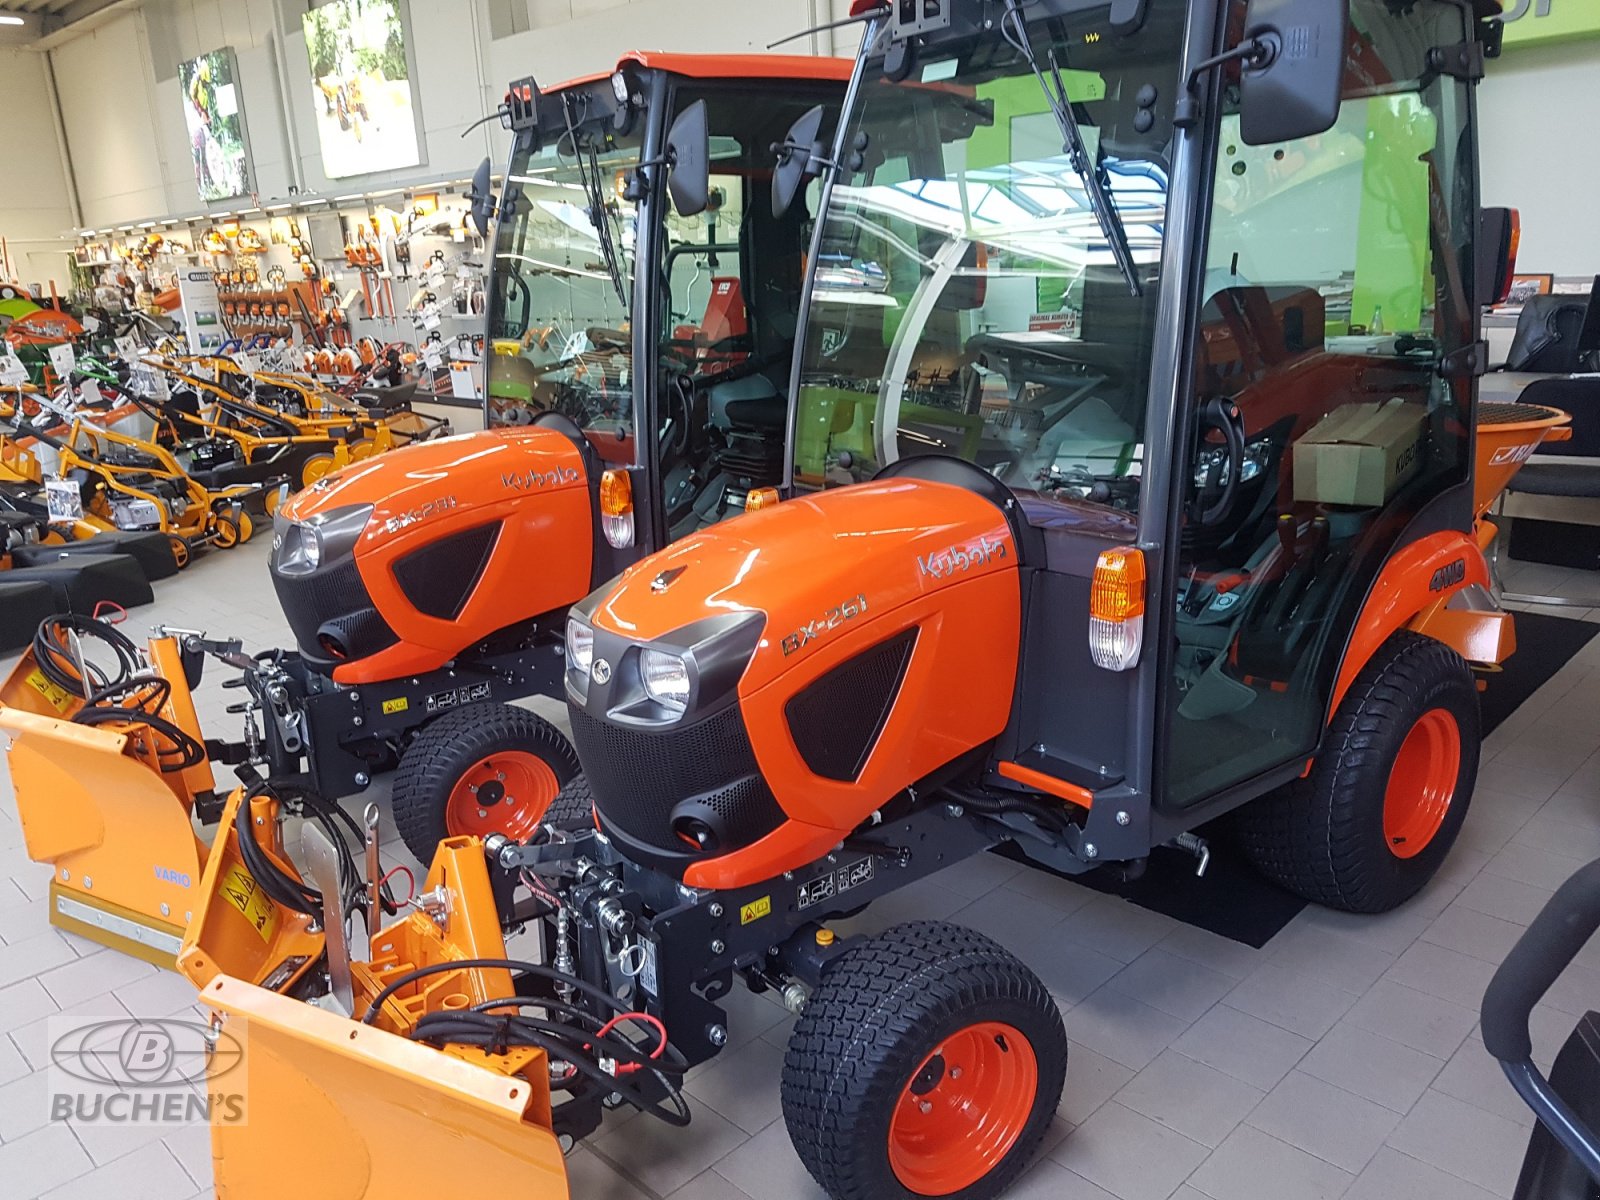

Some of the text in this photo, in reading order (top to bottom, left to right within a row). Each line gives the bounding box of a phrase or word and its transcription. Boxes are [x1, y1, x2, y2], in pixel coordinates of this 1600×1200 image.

[501, 465, 579, 491] Kubota
[916, 536, 1007, 579] Kubota
[1429, 559, 1465, 593] 4WD
[780, 593, 868, 657] BX-261
[154, 864, 191, 888] VARIO
